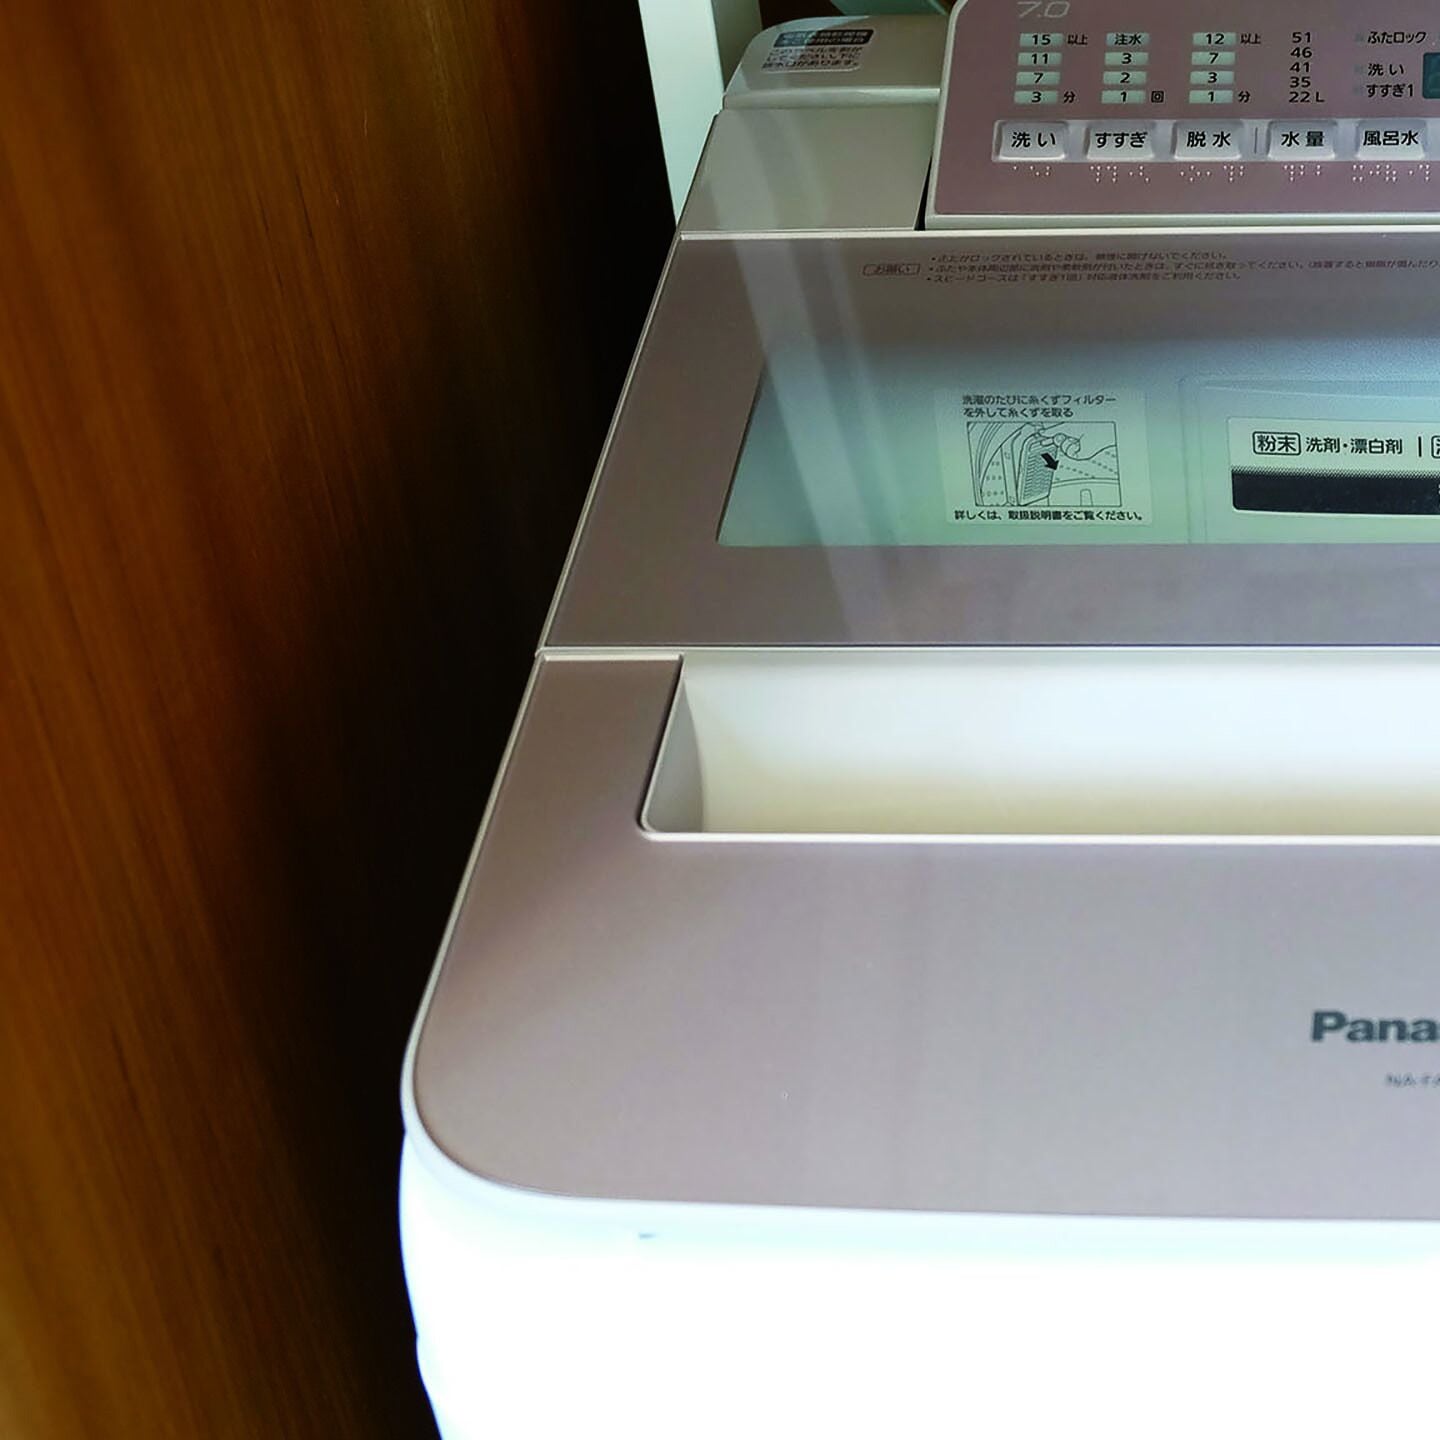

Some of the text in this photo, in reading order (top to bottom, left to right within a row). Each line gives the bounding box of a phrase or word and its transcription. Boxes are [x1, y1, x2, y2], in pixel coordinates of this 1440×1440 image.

[1016, 1, 1070, 18] 7.0
[1032, 33, 1088, 46] 15 以上
[1114, 33, 1142, 46] 注水
[1206, 33, 1261, 45] 12 以上
[1292, 31, 1311, 44] 51
[1367, 31, 1427, 45] ふたロック
[1031, 53, 1049, 65] 11
[1121, 52, 1132, 65] 3
[1209, 52, 1219, 65] 7
[1290, 46, 1313, 59] 46
[1289, 61, 1310, 73] 41
[1367, 63, 1404, 77] 洗い
[1033, 72, 1044, 84] 7
[1119, 71, 1131, 84] 2
[1207, 71, 1218, 84] 3
[1289, 76, 1311, 89] 35
[1120, 90, 1165, 104] 1 回
[1208, 90, 1251, 103] 1 分
[1288, 91, 1325, 103] 22 L
[1366, 83, 1413, 98] すすぎ1
[1031, 91, 1076, 104] 3 分
[1011, 131, 1056, 148] 洗い
[1094, 131, 1148, 149] すすぎ
[1186, 130, 1231, 148] 脱水
[1281, 130, 1325, 148] 水量
[1362, 129, 1419, 146] 風呂水
[963, 394, 1117, 406] 洗濯のたびに糸くずフィルター
[963, 407, 1074, 418] を外して糸くずを取る
[1256, 432, 1298, 453] 粉末
[1305, 436, 1403, 455] 洗剤・漂白剤
[954, 510, 1143, 521] 詳しくは、取扱説明書をご覧ください。
